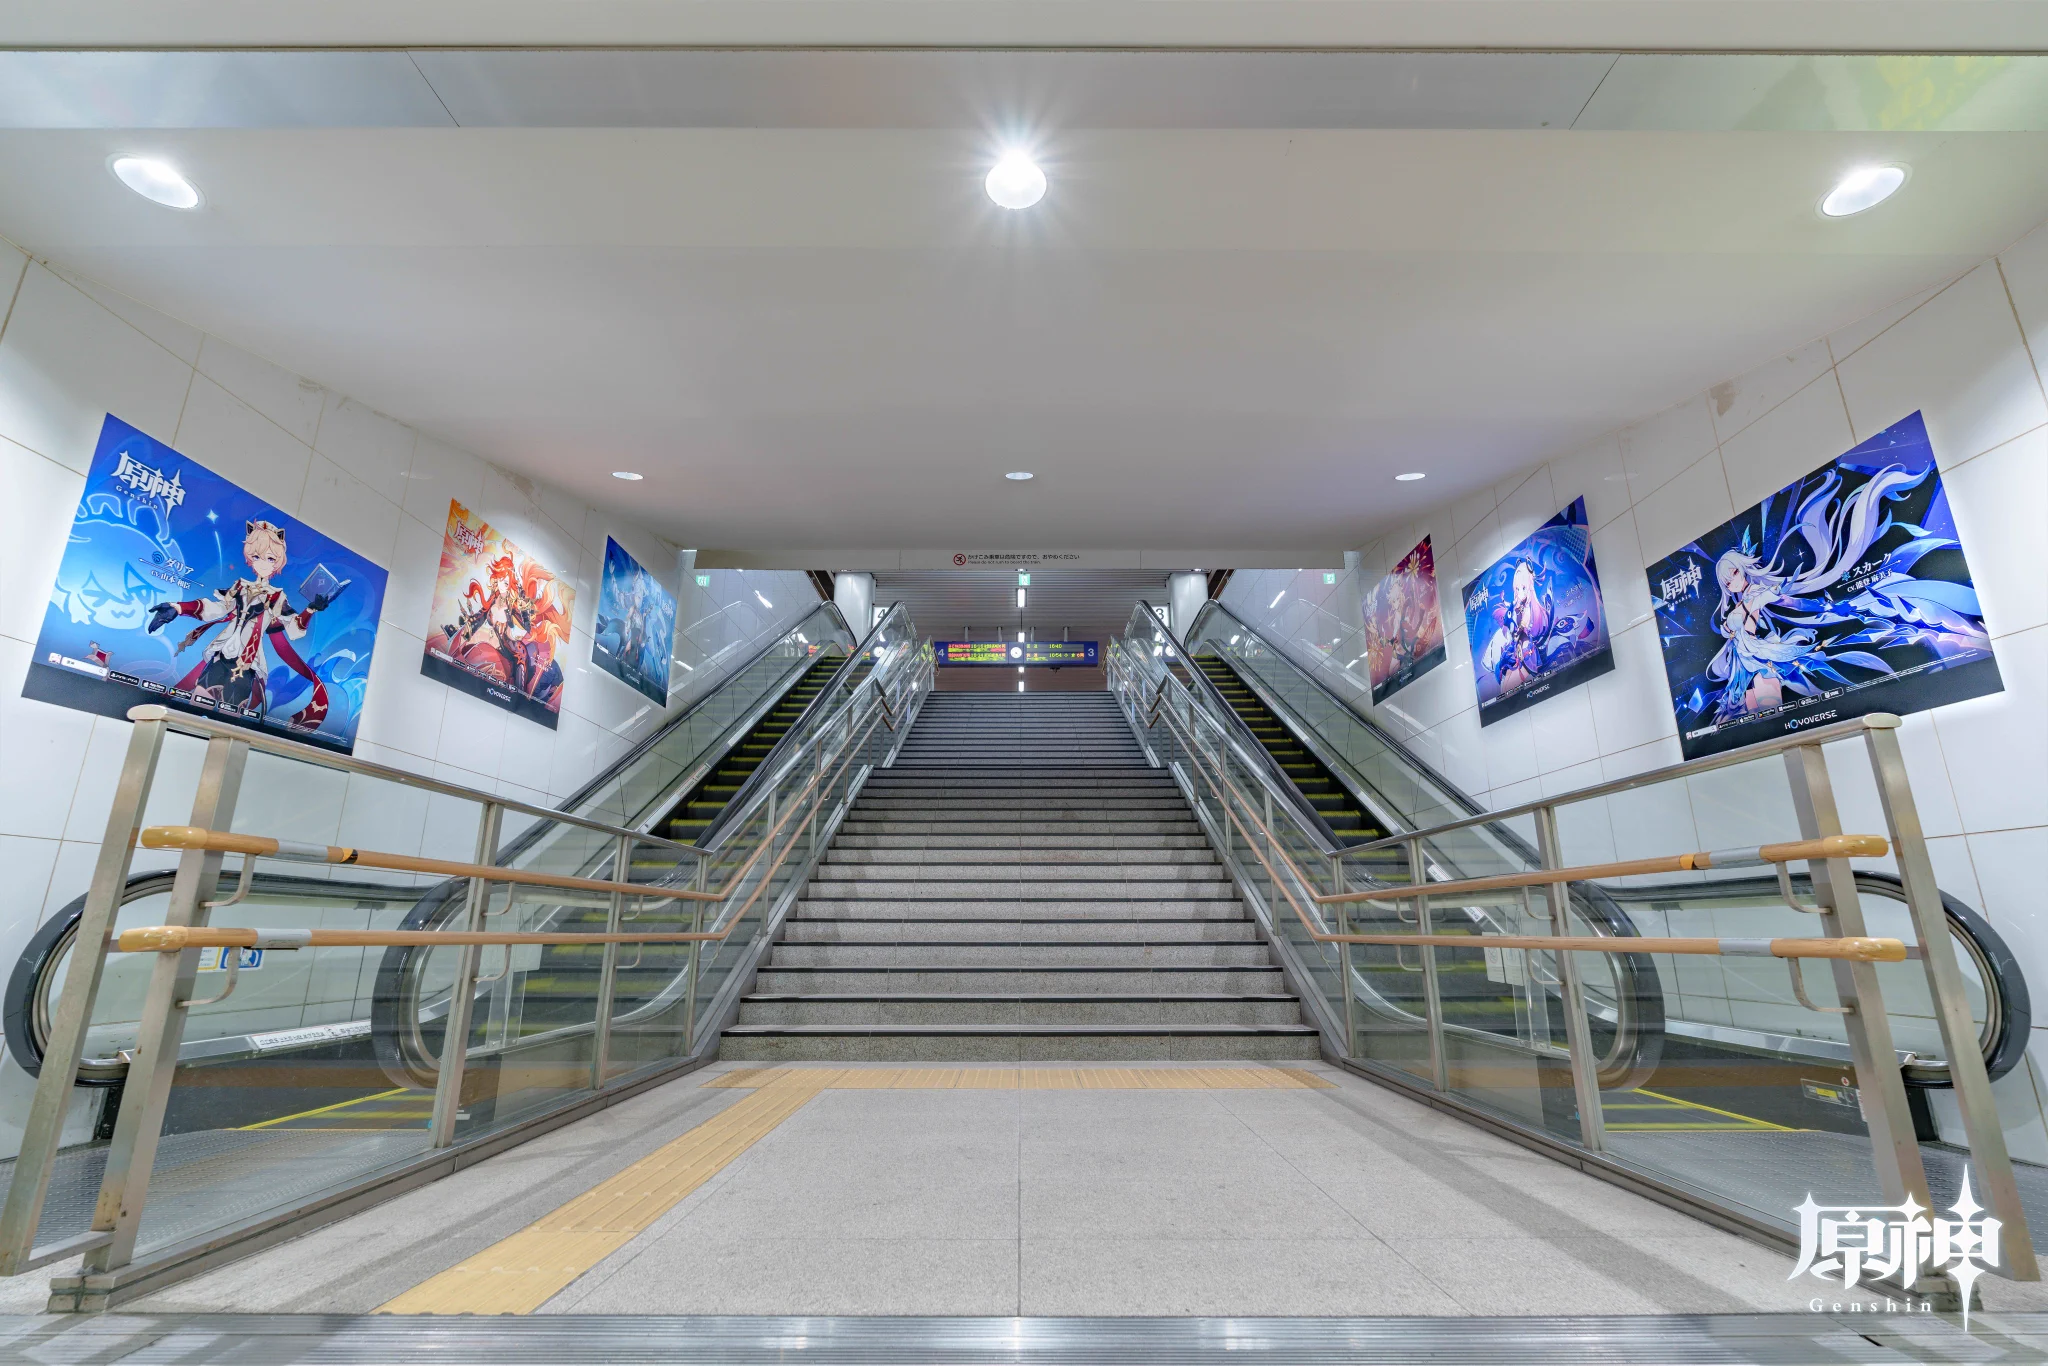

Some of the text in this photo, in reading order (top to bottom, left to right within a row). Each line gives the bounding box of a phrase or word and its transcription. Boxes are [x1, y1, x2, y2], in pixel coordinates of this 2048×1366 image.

[111, 450, 187, 521] 原神
[115, 484, 159, 510] Genshin
[166, 558, 194, 575] ダリア
[1852, 553, 1892, 578] スカーク
[1660, 555, 1703, 602] 原神
[1155, 607, 1165, 620] 3
[937, 648, 945, 657] 4
[1087, 648, 1095, 657] 3
[1784, 709, 1838, 730] HOYOVERSE
